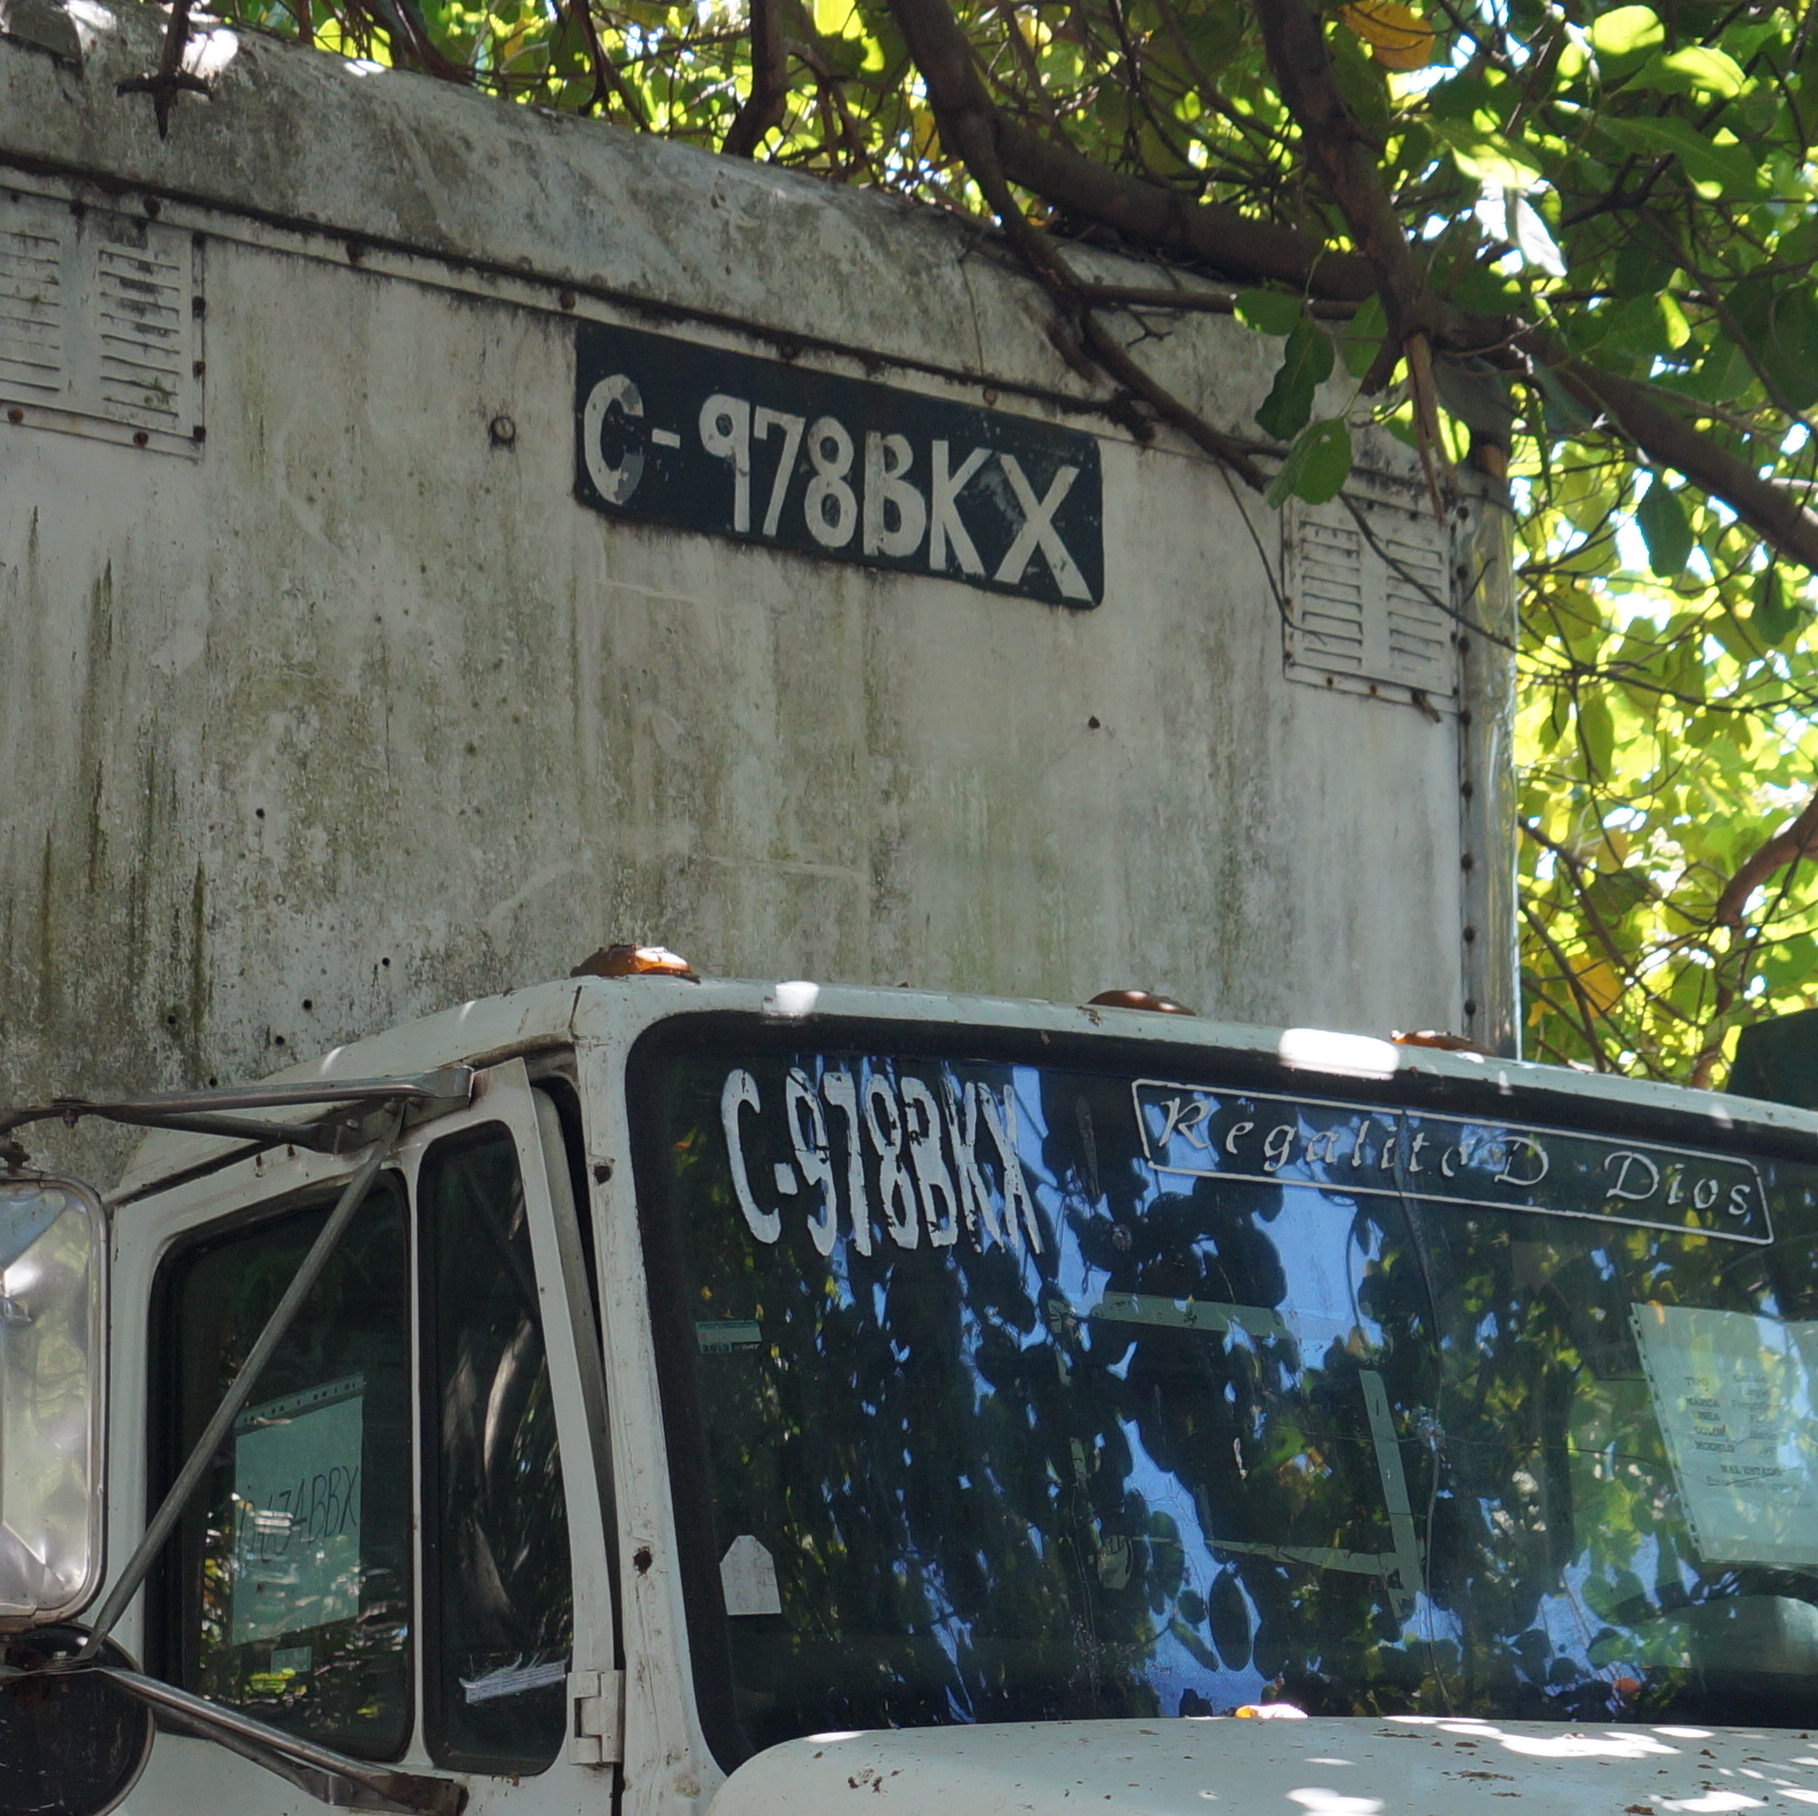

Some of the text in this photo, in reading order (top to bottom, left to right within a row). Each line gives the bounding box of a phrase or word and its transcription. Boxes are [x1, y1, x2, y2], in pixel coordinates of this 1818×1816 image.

[584, 374, 1094, 603] C-978BKX
[720, 1067, 1044, 1257] C-978BKX
[1494, 1136, 1551, 1187] D
[1603, 1151, 1752, 1217] Dios
